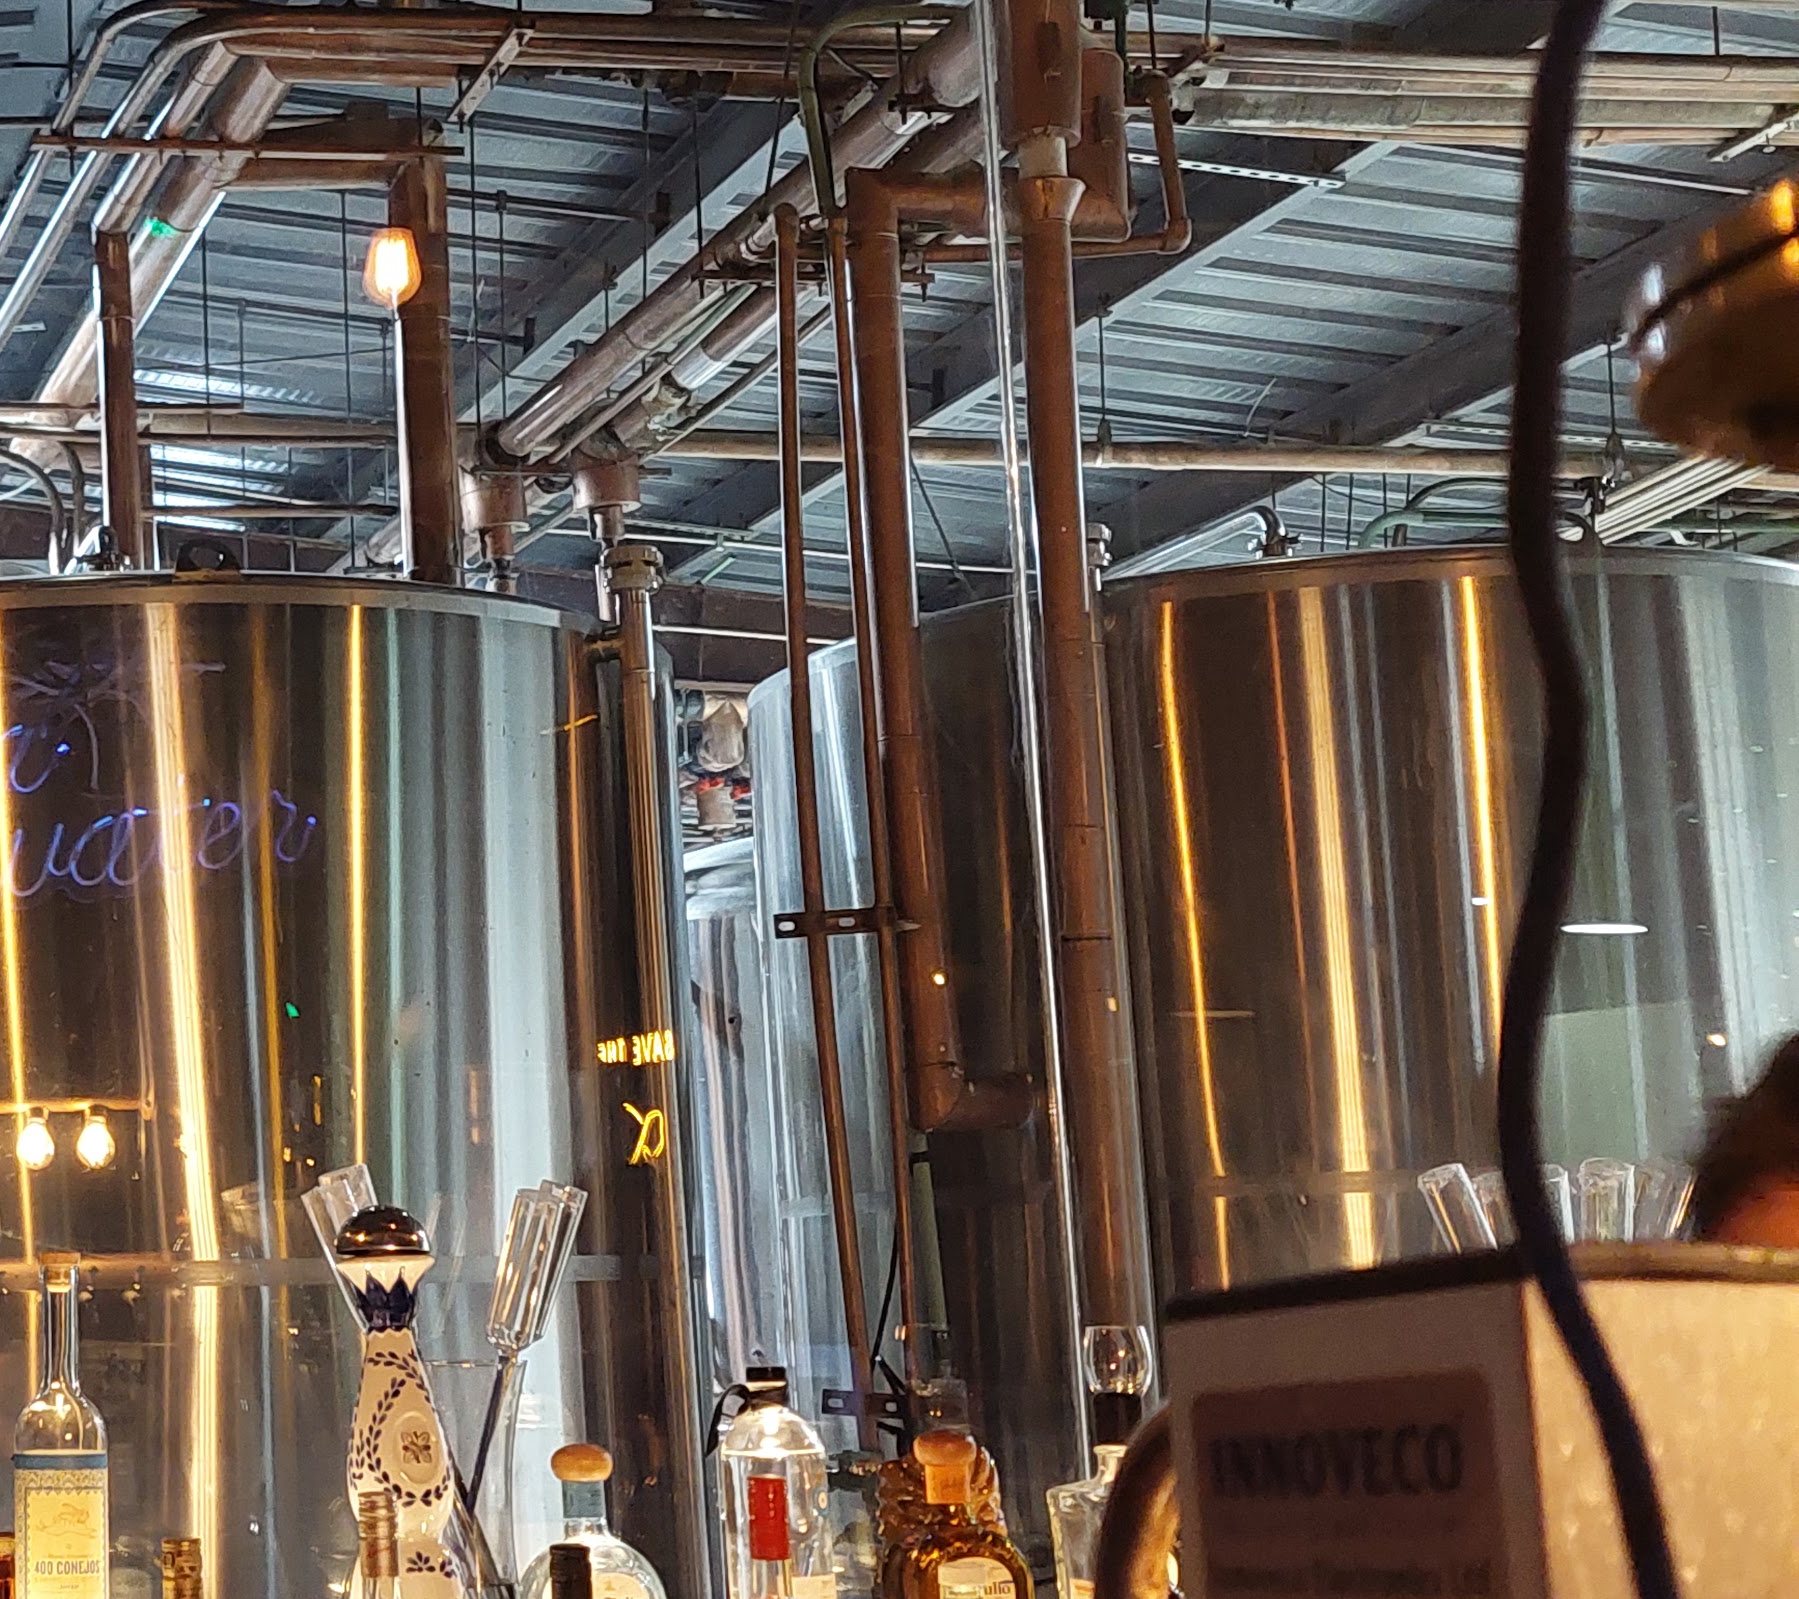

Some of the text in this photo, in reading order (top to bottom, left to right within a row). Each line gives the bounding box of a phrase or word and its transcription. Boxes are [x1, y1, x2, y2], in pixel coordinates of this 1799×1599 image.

[1208, 1423, 1465, 1498] INNOVECO
[34, 1559, 101, 1576] 400 CONEJOS
[984, 1582, 1011, 1595] ulio
